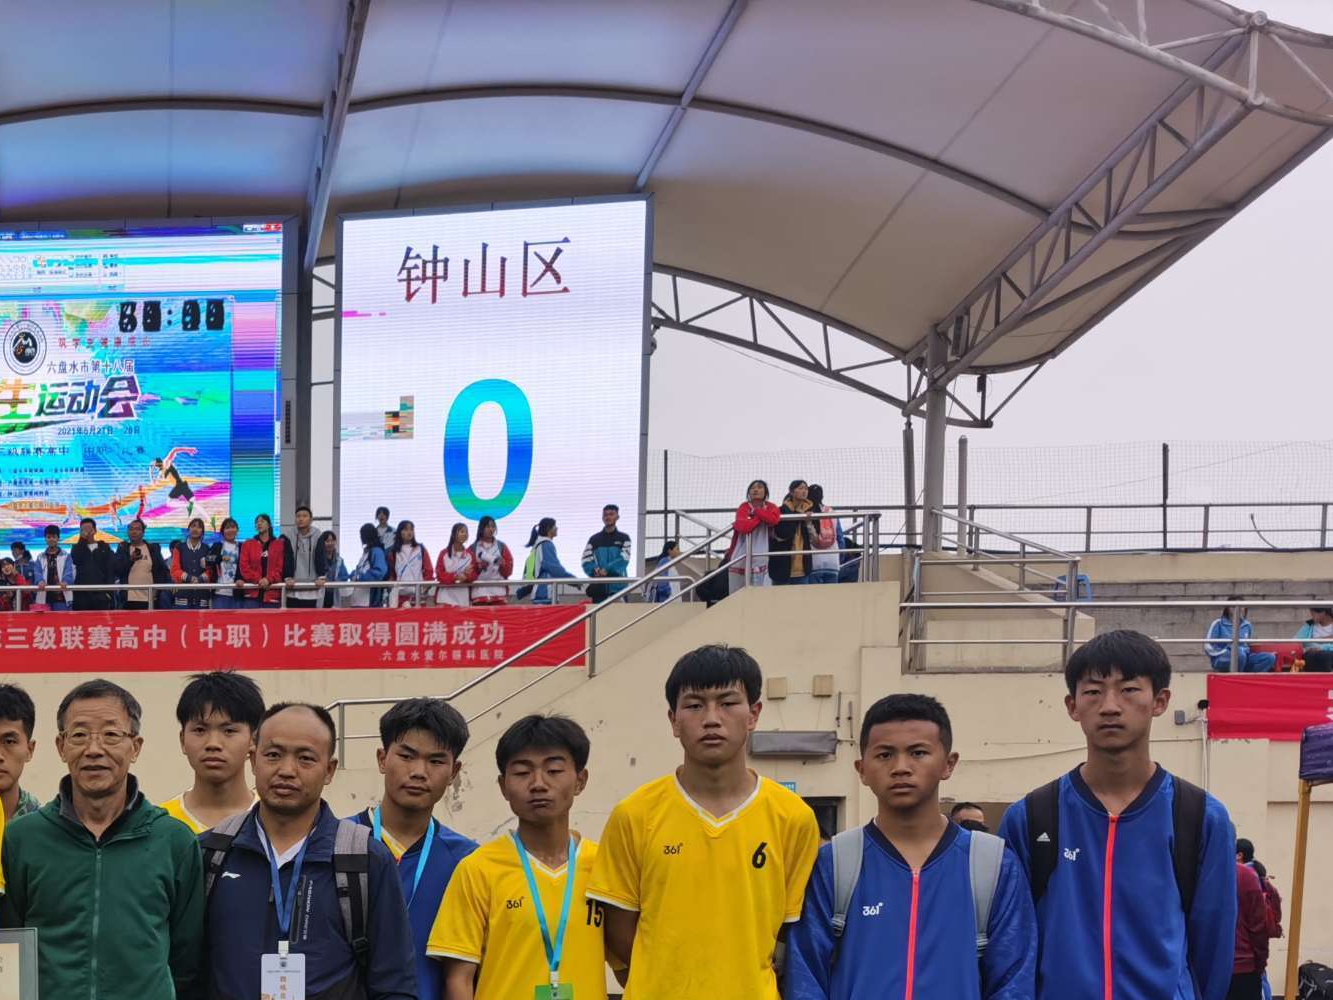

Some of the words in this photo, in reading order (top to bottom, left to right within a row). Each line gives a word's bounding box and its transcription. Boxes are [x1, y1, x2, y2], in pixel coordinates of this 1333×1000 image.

[397, 237, 571, 304] 钟山区
[46, 359, 135, 375] 六盘水市第十八届
[443, 378, 533, 521] 0
[382, 650, 504, 662] 六盘水爱尔眼科医院
[751, 841, 767, 869] 6
[585, 899, 603, 928] 15
